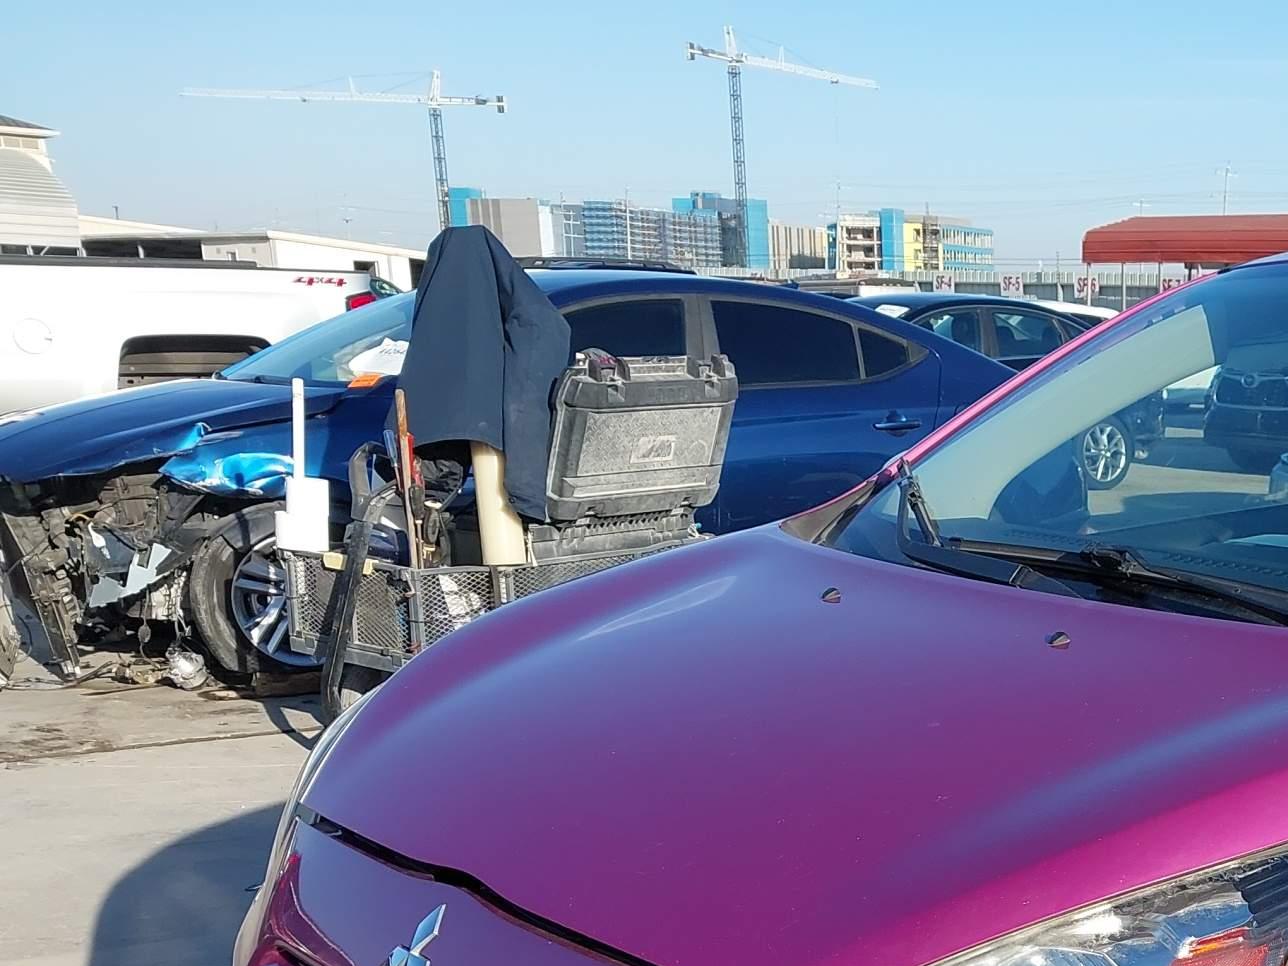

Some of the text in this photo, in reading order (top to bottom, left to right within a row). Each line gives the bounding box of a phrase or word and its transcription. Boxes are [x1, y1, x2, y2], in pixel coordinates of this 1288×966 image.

[936, 275, 952, 290] SF-4
[1003, 276, 1020, 292] SF-5
[1077, 277, 1097, 294] SF6
